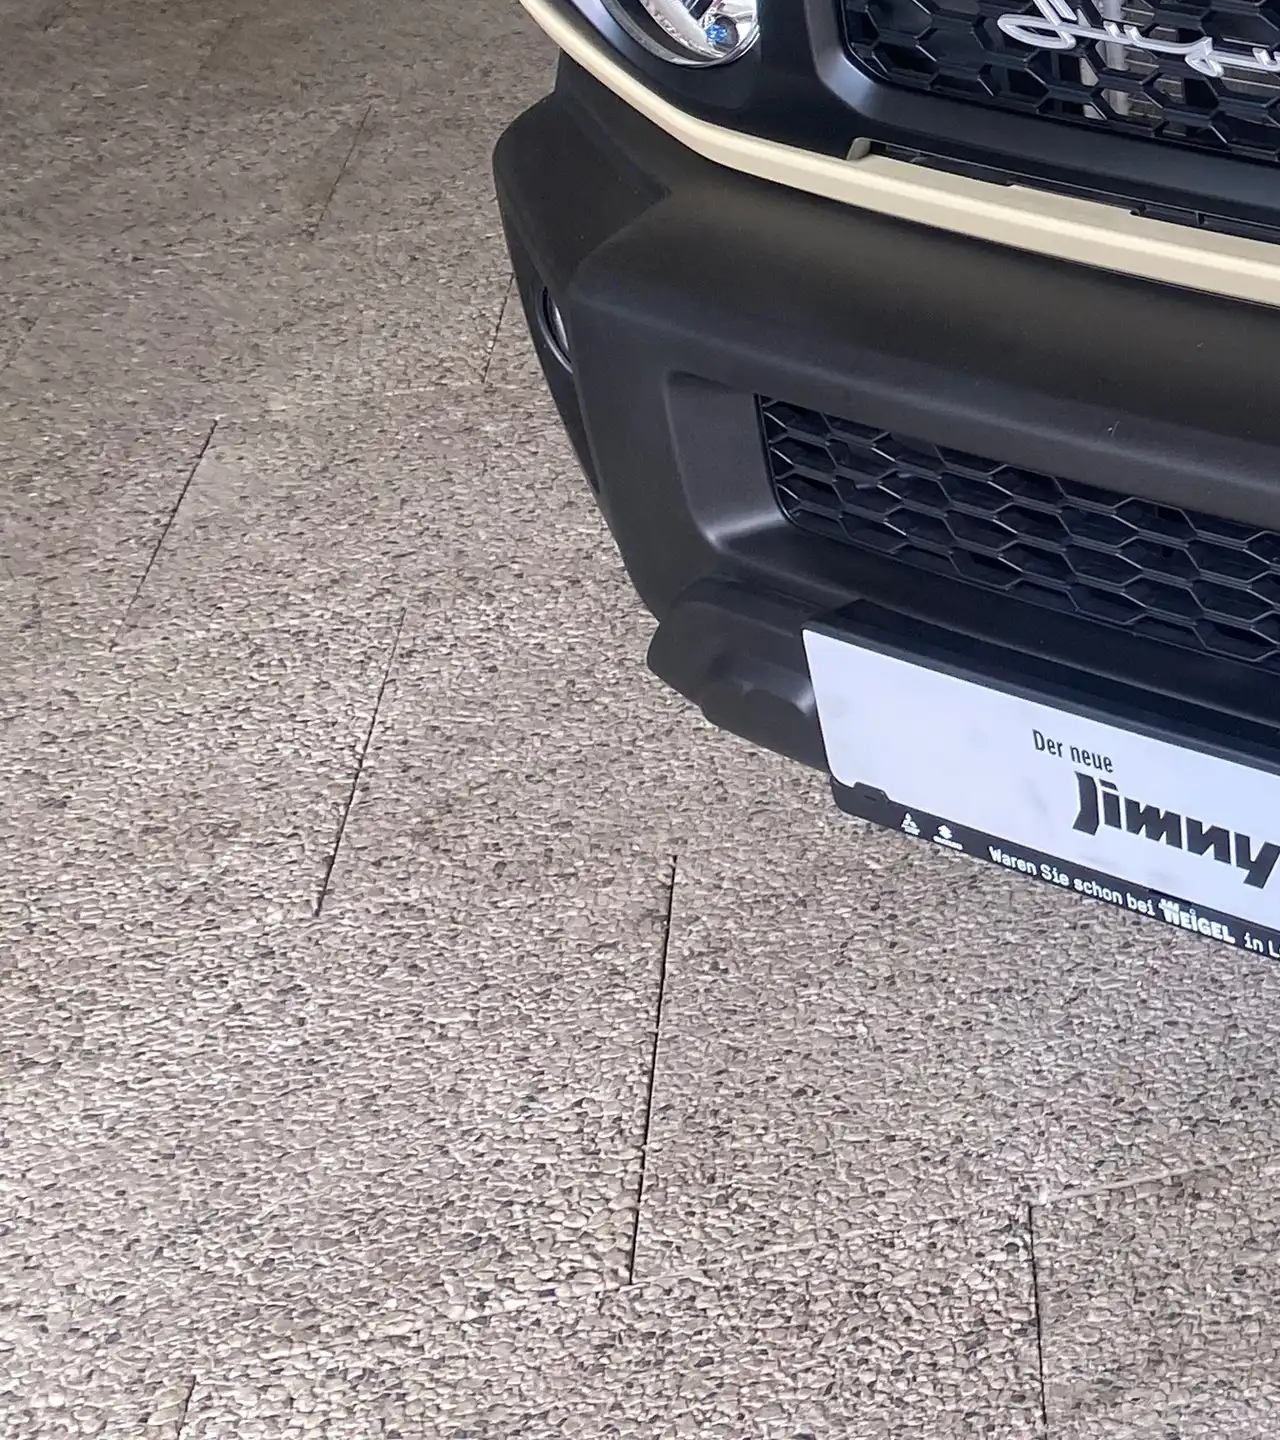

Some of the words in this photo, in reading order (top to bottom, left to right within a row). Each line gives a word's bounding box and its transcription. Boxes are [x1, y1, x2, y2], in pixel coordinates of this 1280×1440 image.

[1032, 728, 1063, 758] Der
[1070, 744, 1114, 773] neue
[988, 845, 1037, 876] Waren
[1040, 863, 1069, 886] Sie
[1073, 877, 1123, 906] schon
[1126, 892, 1156, 916] bei
[1244, 932, 1264, 953] in
